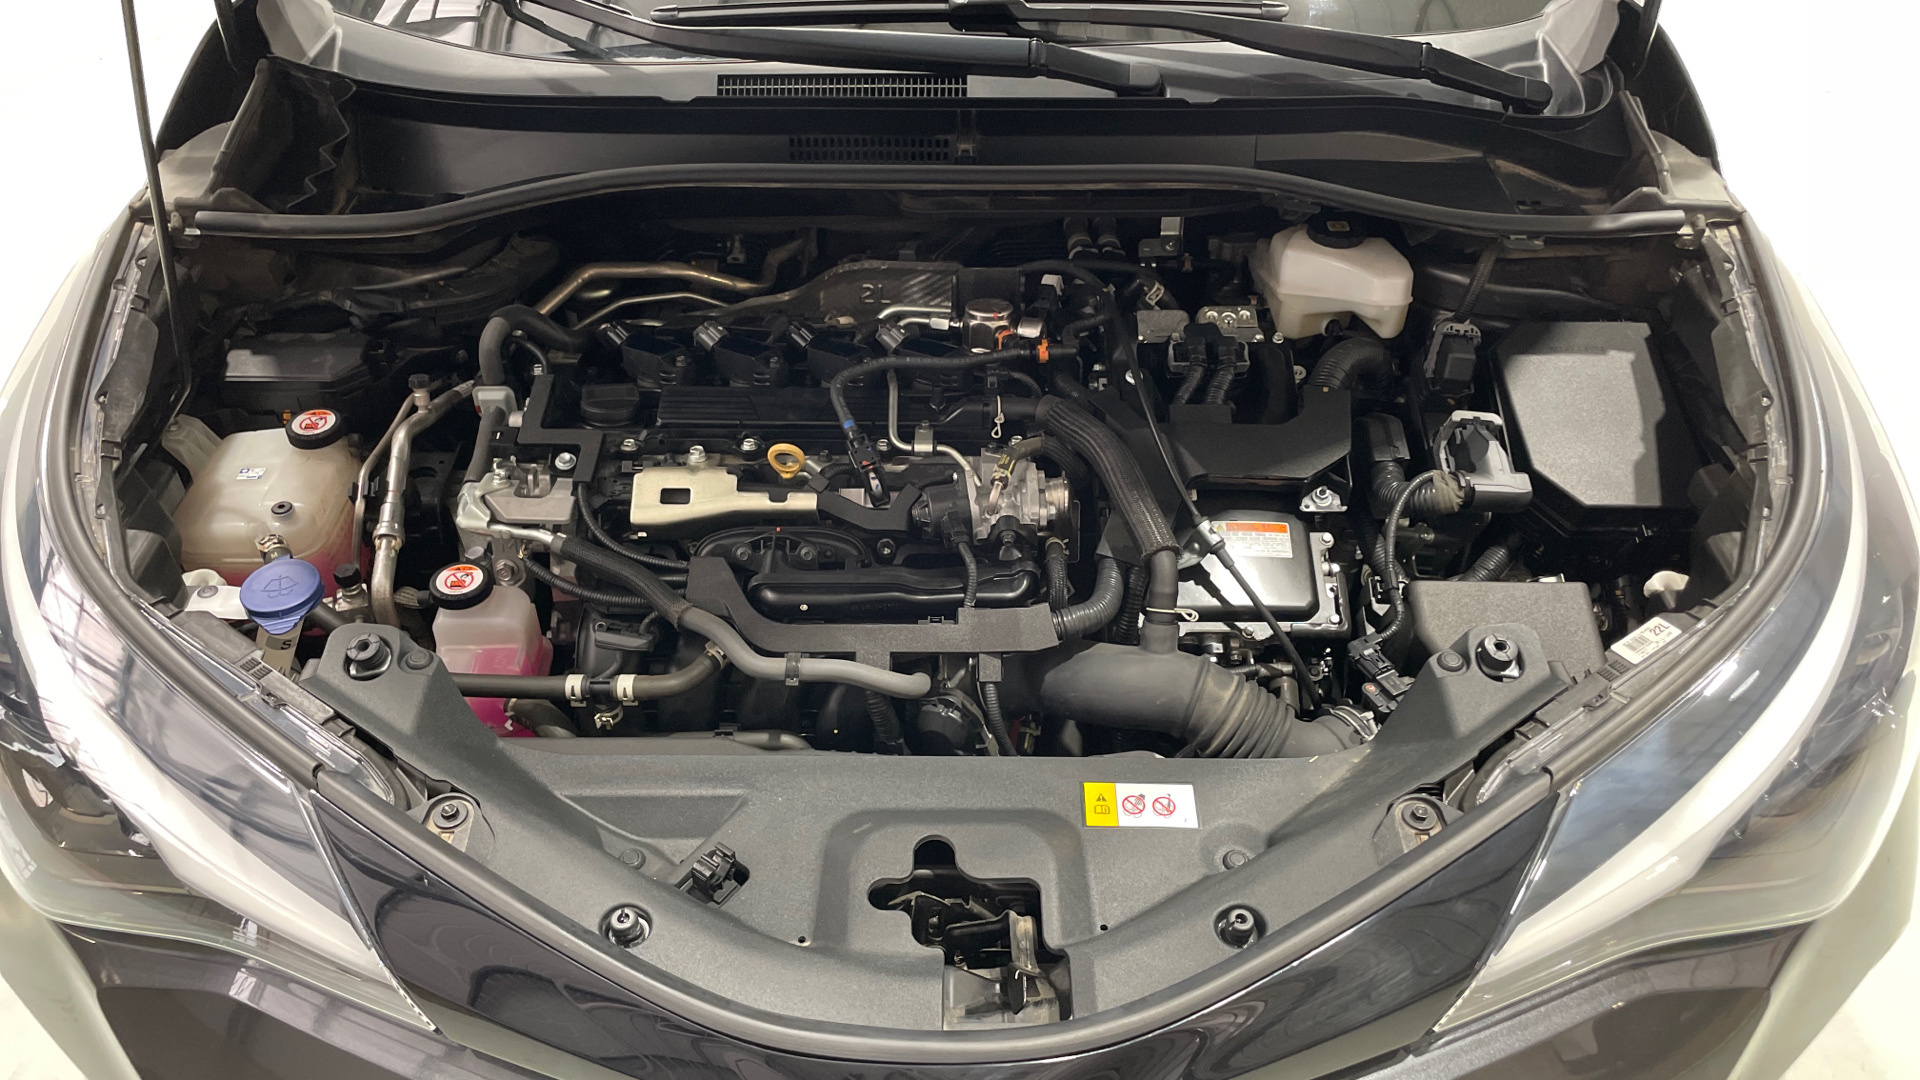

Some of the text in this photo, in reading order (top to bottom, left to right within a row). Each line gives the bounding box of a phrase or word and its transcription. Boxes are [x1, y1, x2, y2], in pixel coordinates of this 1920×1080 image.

[860, 283, 891, 303] 2L
[1649, 623, 1671, 637] 22L
[280, 639, 292, 650] S
